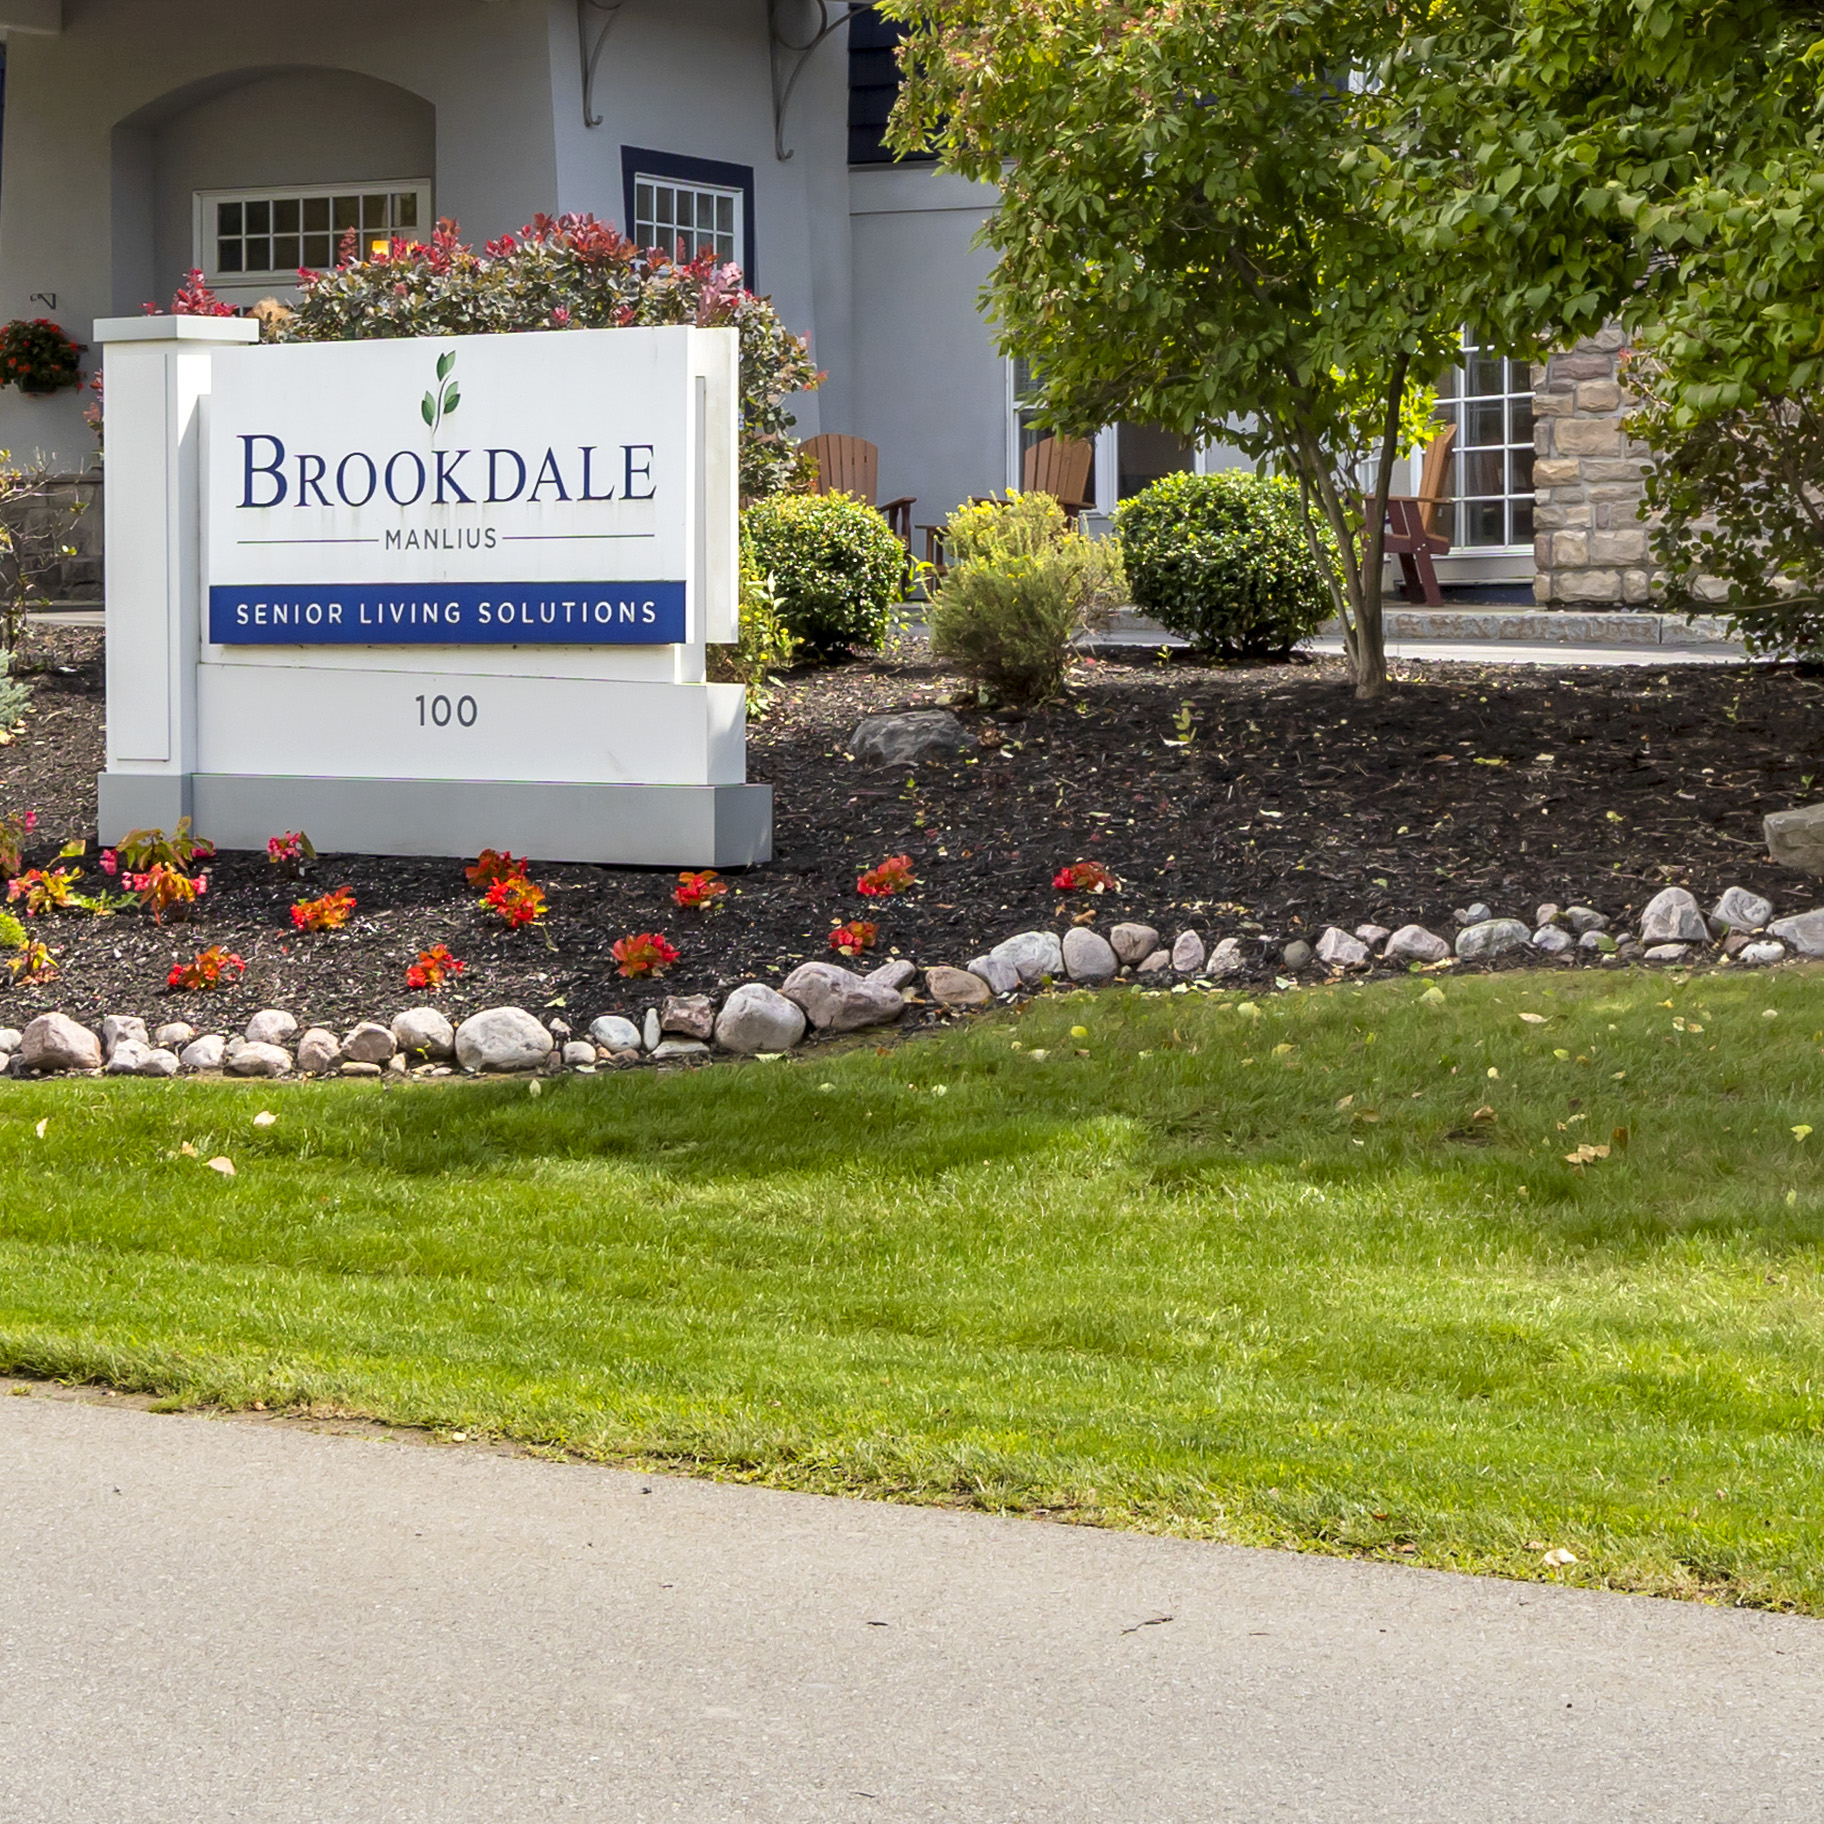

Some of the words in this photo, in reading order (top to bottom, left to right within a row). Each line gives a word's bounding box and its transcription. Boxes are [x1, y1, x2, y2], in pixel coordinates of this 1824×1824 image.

[237, 434, 656, 508] BROOKDALE
[385, 528, 497, 549] MANLIUS
[237, 603, 342, 625] SENIOR
[360, 603, 460, 624] LIVING
[479, 601, 656, 624] SOLUTIONS
[416, 694, 478, 727] 100
